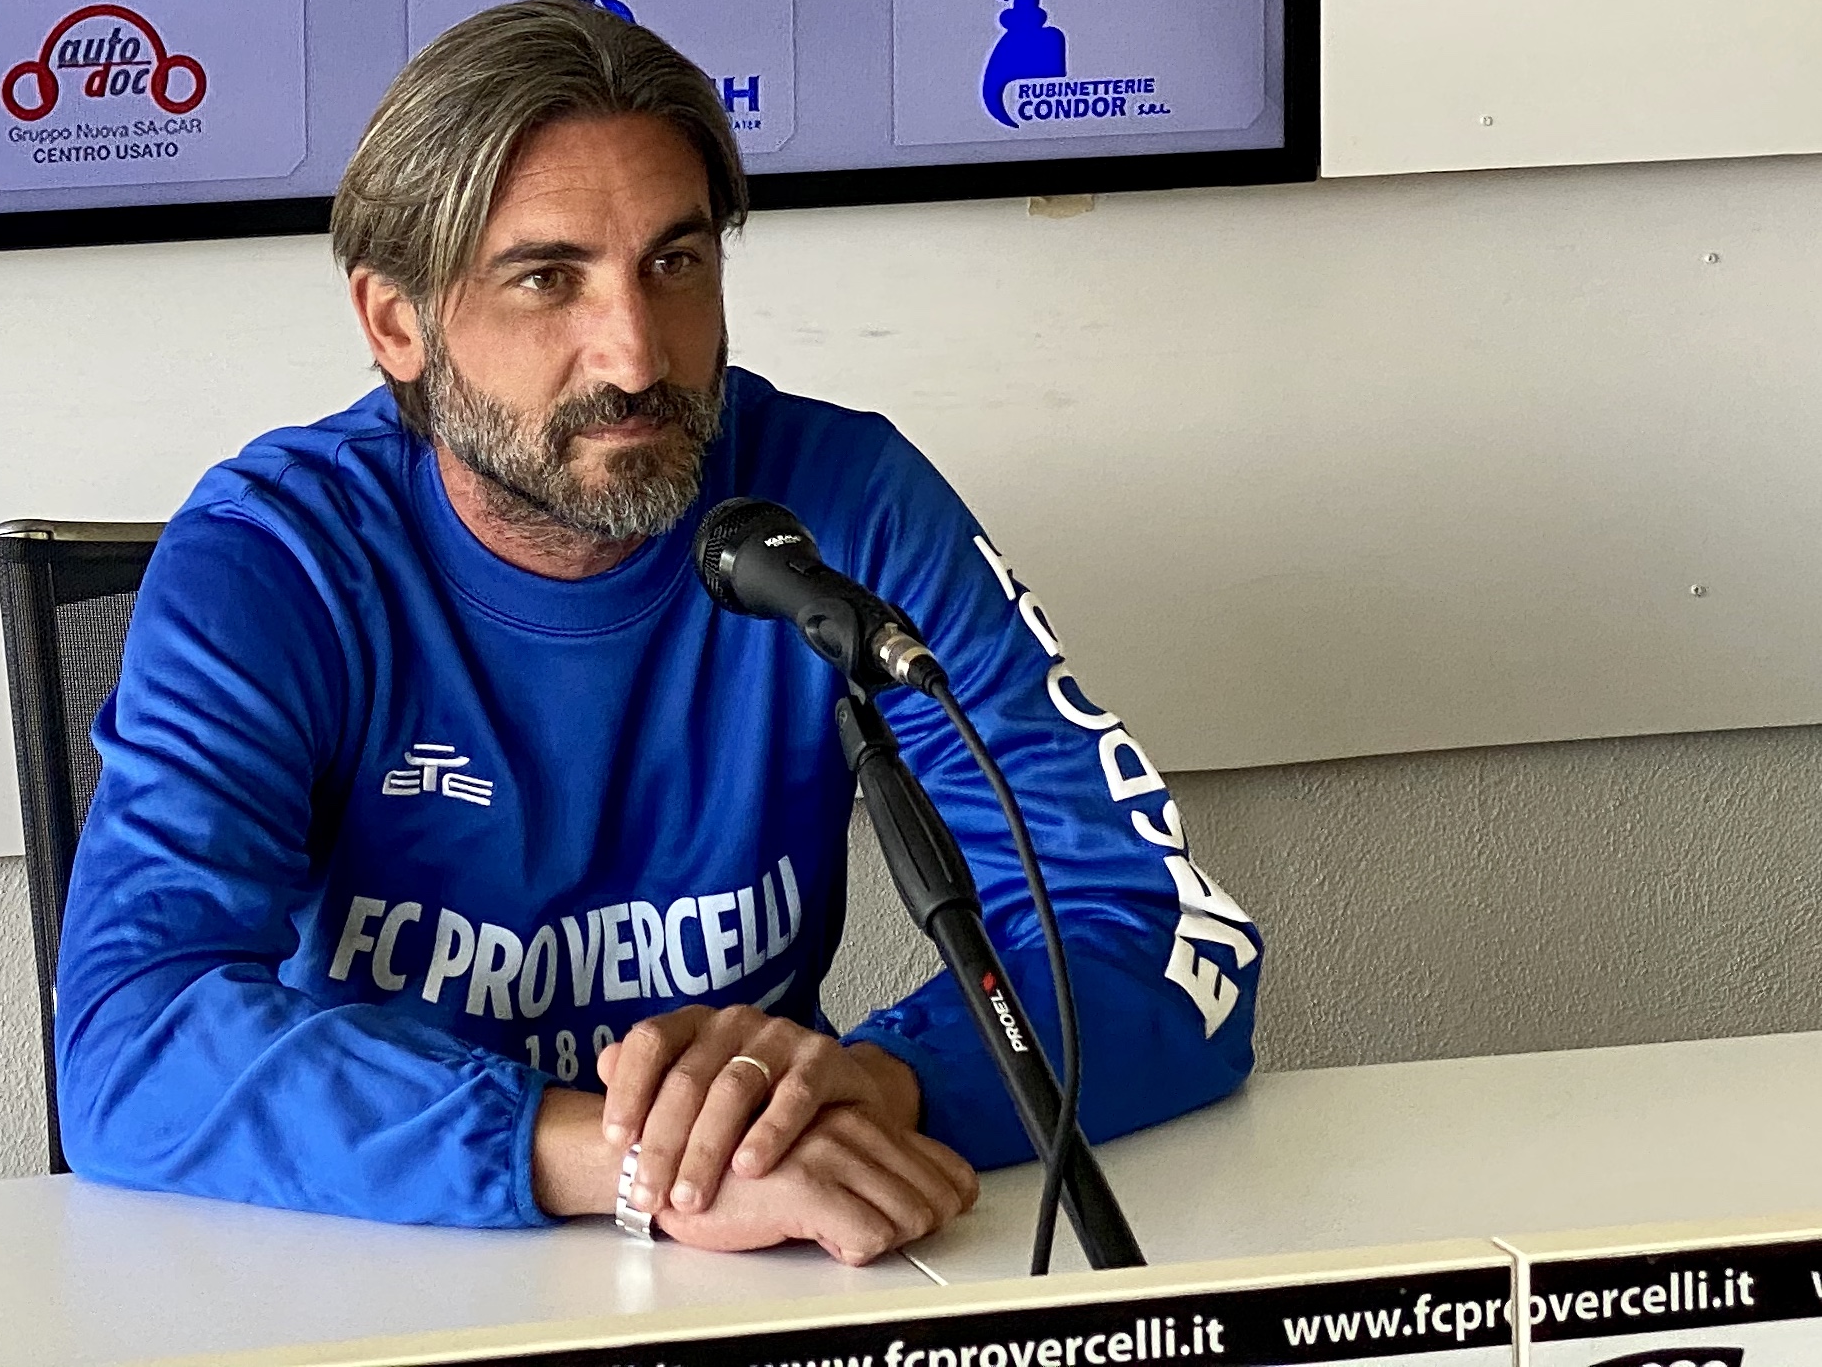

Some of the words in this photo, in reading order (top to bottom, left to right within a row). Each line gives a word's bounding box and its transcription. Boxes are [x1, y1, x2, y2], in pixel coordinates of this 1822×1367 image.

[58, 27, 140, 65] auto
[84, 62, 150, 98] doc
[1017, 77, 1155, 100] RUBINETTERIE
[1017, 97, 1127, 121] CONDOR
[9, 126, 73, 145] Gruppo
[77, 123, 130, 140] Nuova
[133, 118, 203, 137] SA-CAR
[33, 145, 111, 164] CENTRO
[115, 142, 179, 160] USATO
[328, 895, 423, 992] FC
[421, 908, 559, 1020] PRO
[560, 855, 803, 1008] VERCELLI
[989, 988, 1029, 1052] PROEL
